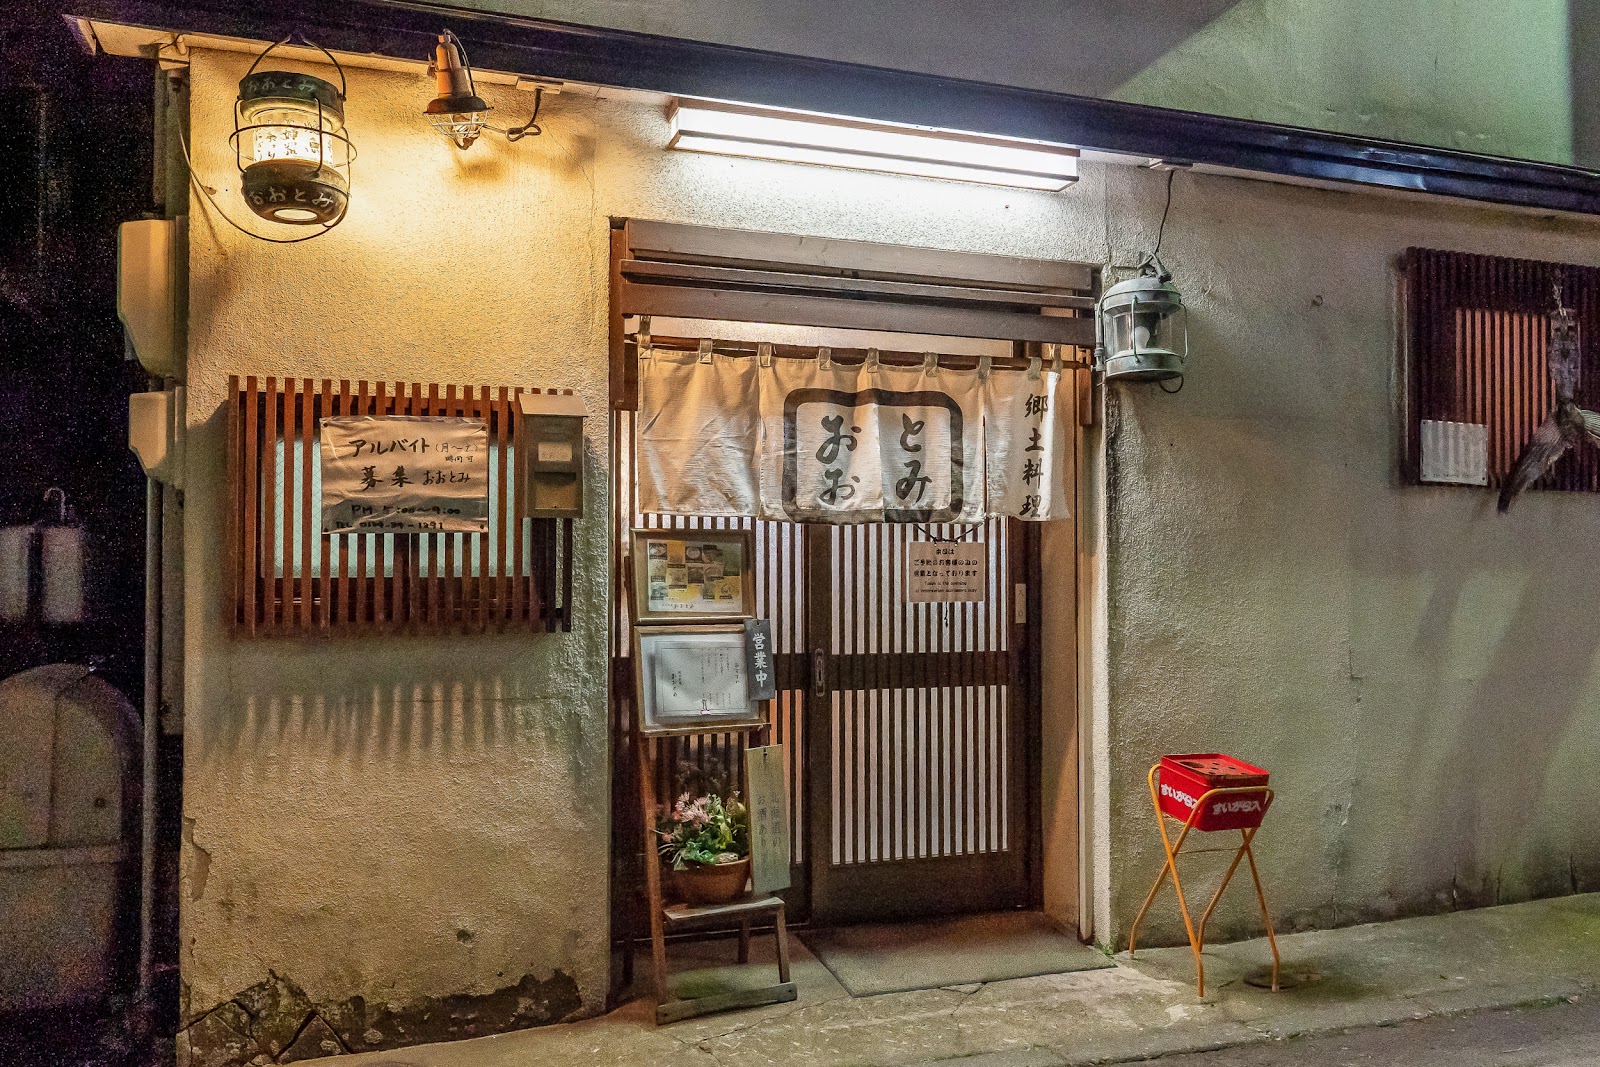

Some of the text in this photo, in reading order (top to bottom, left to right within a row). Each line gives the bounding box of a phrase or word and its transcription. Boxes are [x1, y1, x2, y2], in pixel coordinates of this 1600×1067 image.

[348, 437, 430, 457] アルバイト
[815, 414, 861, 506] おお
[895, 412, 932, 503] とみ
[1019, 393, 1049, 519] 郷土料理
[422, 470, 471, 486] おおとみ
[351, 504, 373, 515] PM
[752, 632, 768, 688] 営業中
[1212, 800, 1261, 815] すいがら入
